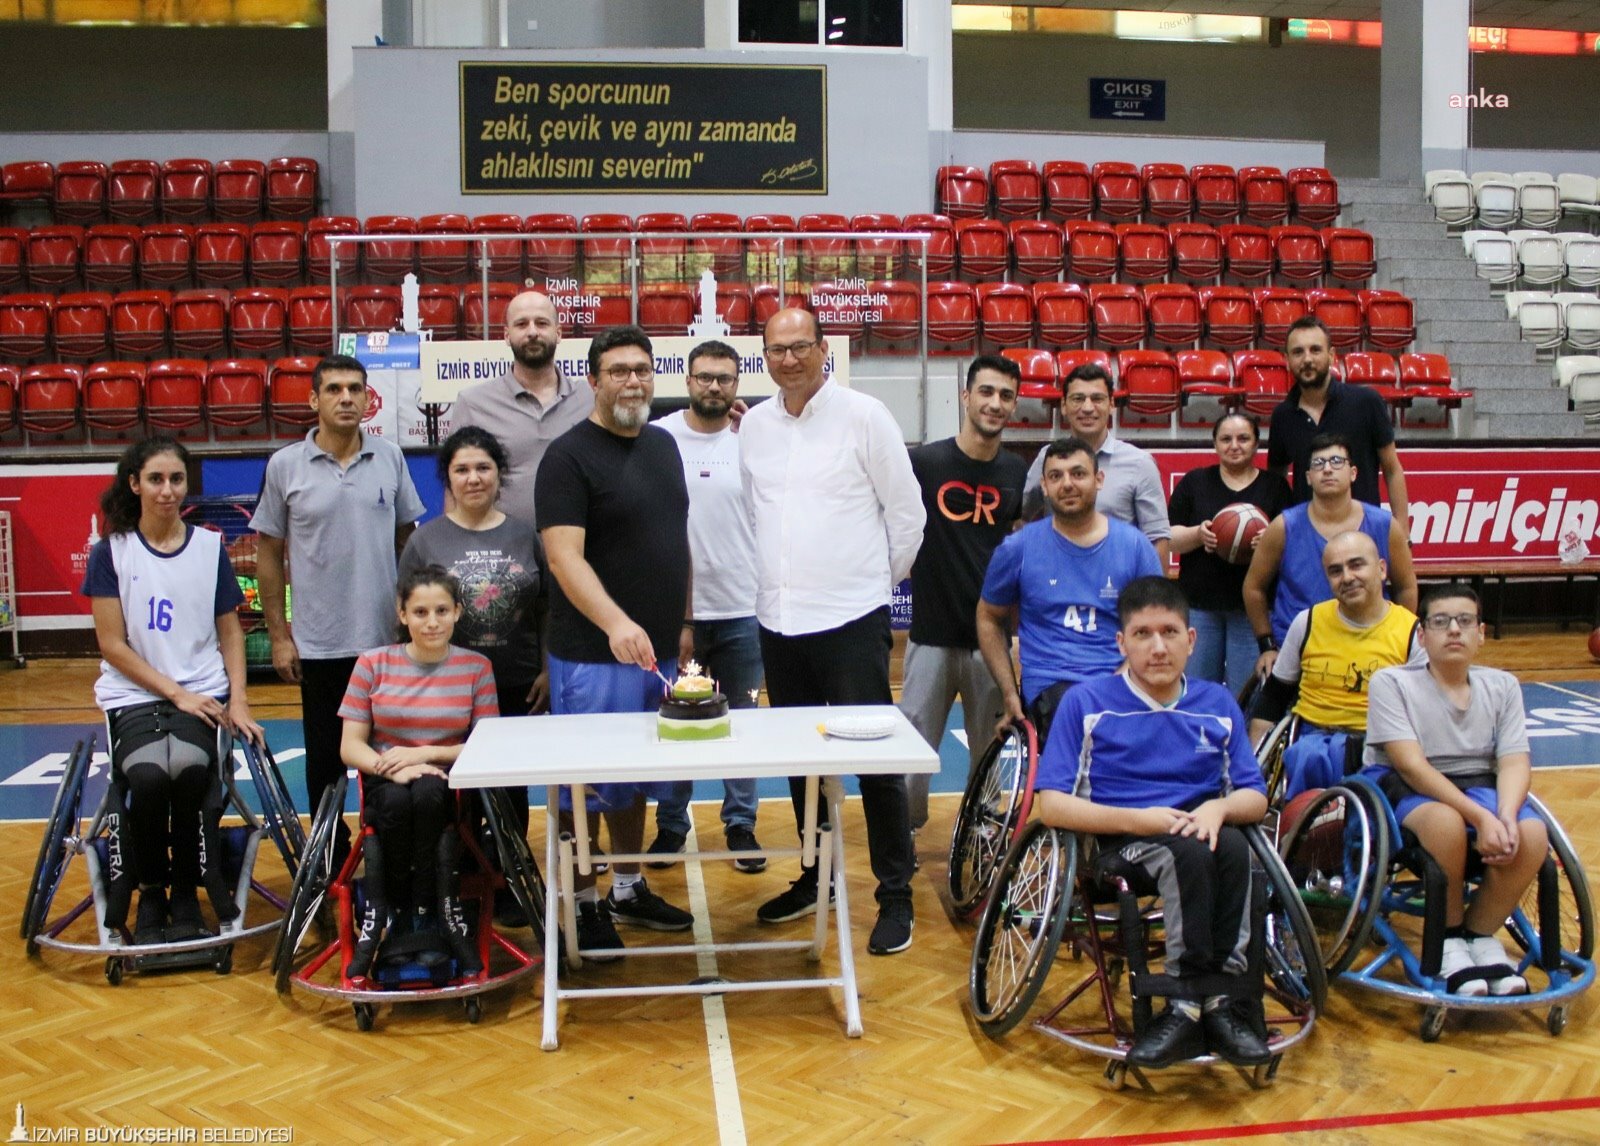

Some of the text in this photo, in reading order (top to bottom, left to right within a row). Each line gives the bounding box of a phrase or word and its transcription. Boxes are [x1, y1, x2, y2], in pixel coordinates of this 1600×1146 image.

[494, 76, 671, 110] Ben sporcunun
[1103, 82, 1152, 98] ÇIKIŞ
[1115, 100, 1140, 109] EXIT
[480, 114, 797, 148] zeki, çevik ve aynı zamanda
[481, 152, 704, 179] ahlaklısını severim"
[545, 277, 578, 291] İZMİR
[834, 277, 866, 290] İZMİR
[812, 292, 889, 309] BÜYÜKŞEHİR
[558, 310, 595, 324] DİYESİ
[819, 309, 883, 323] BELEDİYESİ
[437, 358, 470, 380] İZMİR
[474, 358, 511, 379] BÜYÜ
[653, 353, 685, 375] ZMİR
[739, 352, 764, 374] EHİR
[148, 596, 173, 632] 16
[108, 813, 123, 881] EXTRA
